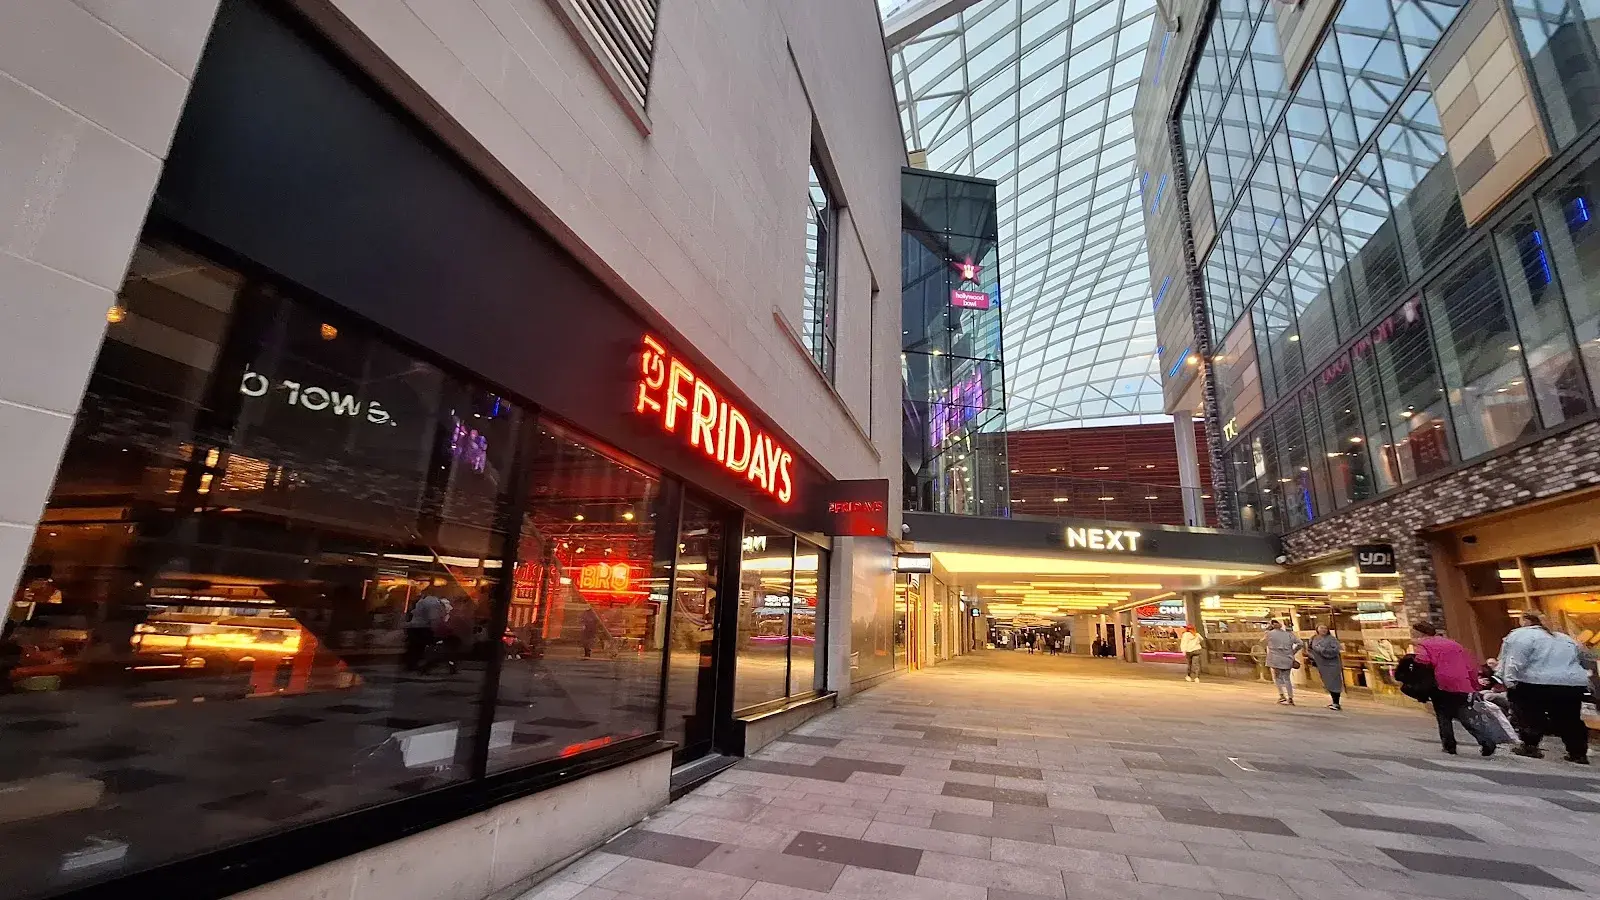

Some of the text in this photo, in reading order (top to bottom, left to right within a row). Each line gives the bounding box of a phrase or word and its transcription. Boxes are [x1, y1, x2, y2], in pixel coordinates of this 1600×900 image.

[955, 291, 984, 300] hollywood
[637, 333, 793, 504] TGI FRIDAYS
[1066, 527, 1141, 552] NEXT
[1360, 552, 1391, 566] YO!
